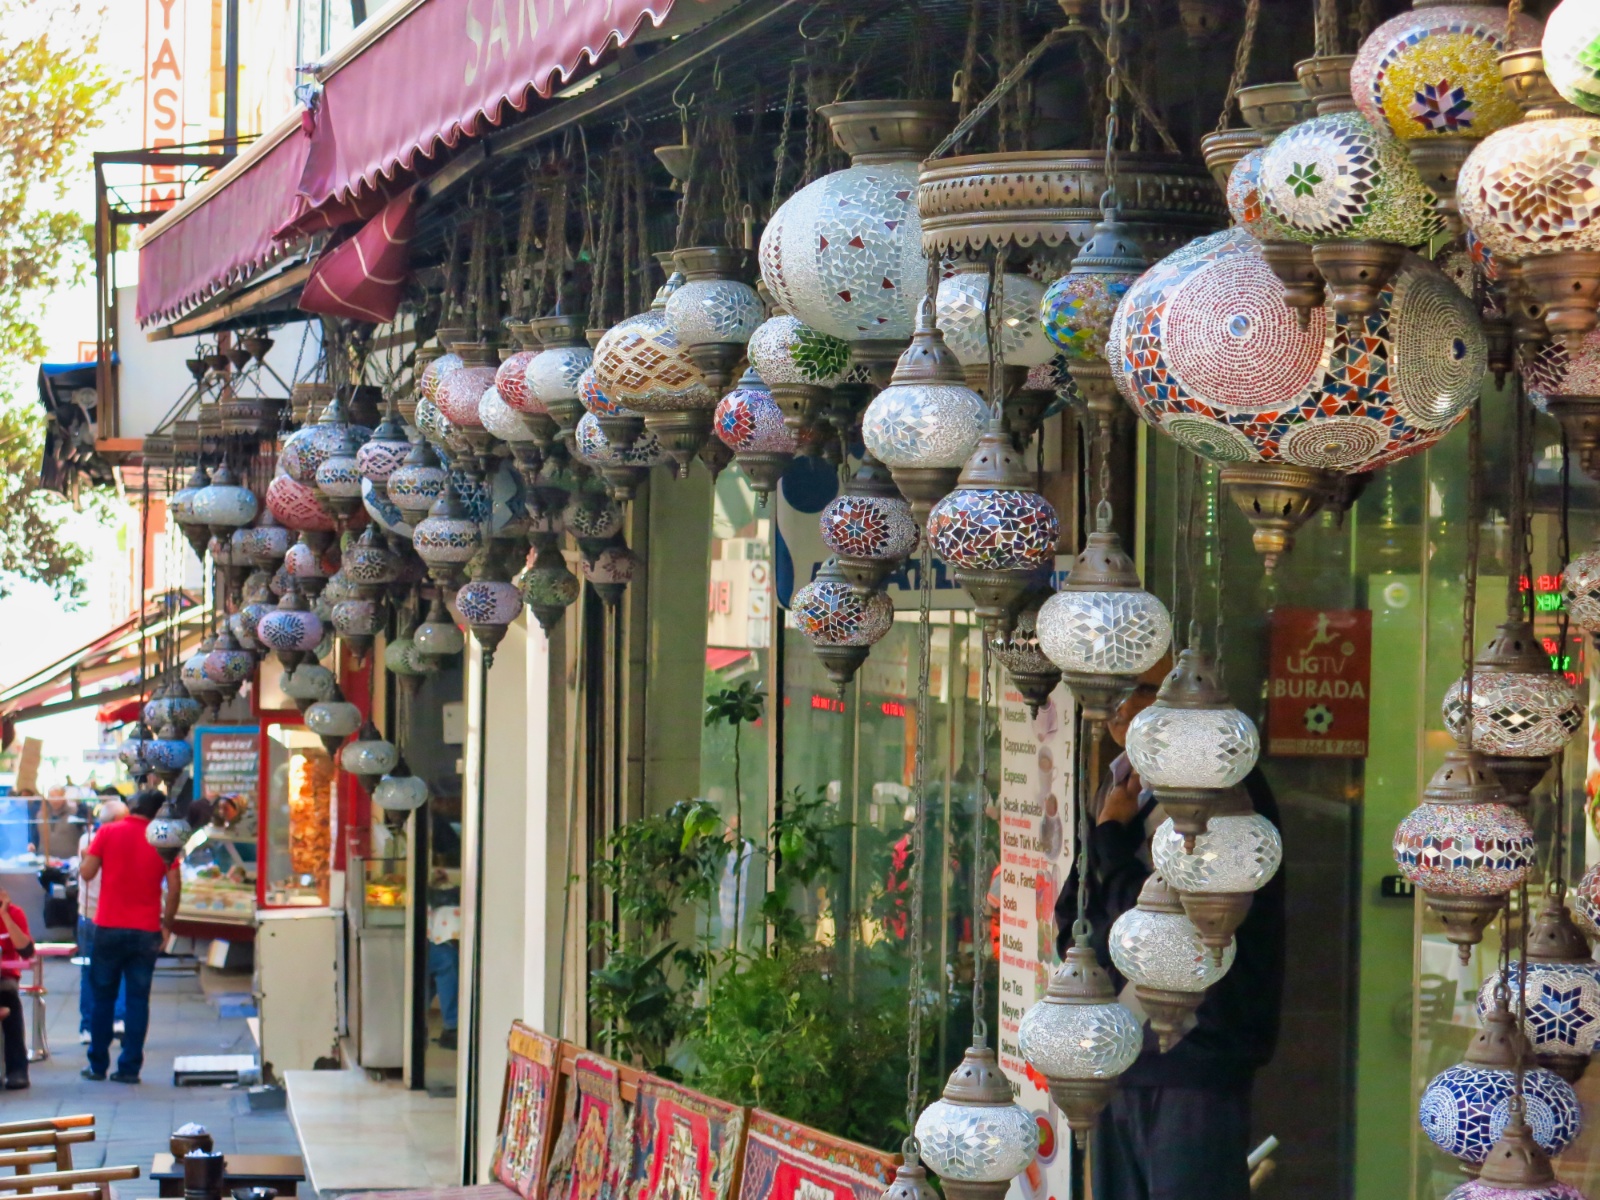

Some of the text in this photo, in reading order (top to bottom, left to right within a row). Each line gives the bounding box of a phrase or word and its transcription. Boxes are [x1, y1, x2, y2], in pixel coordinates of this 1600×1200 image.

[1274, 678, 1365, 699] BURADA
[1004, 737, 1037, 756] Cappuccino
[1065, 741, 1071, 760] 7
[1064, 773, 1070, 796] 7
[1064, 802, 1069, 823] 8
[1063, 839, 1070, 857] 5
[1003, 868, 1016, 884] Cola
[1020, 872, 1036, 889] Fanta
[1003, 895, 1017, 911] Soda
[1002, 933, 1023, 952] M.Soda
[1002, 977, 1023, 996] Ice Tea
[1001, 1001, 1020, 1021] Meyve
